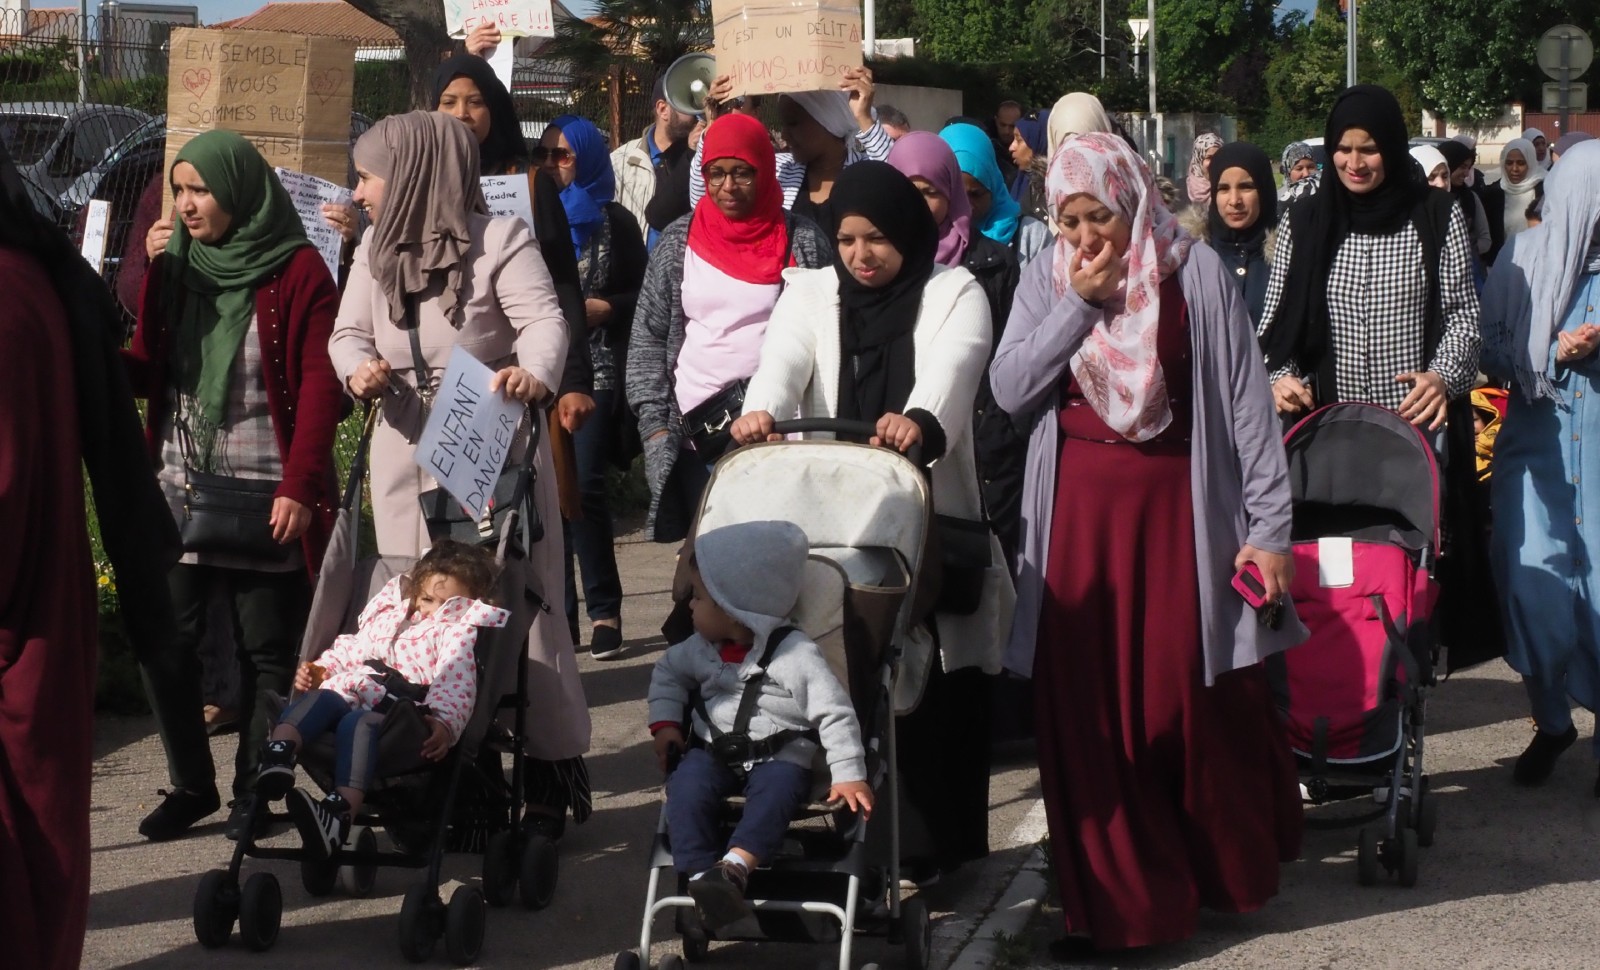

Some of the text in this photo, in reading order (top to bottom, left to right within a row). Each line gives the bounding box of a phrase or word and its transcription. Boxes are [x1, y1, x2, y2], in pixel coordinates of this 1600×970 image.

[465, 12, 518, 33] FARE
[722, 26, 758, 50] C'EST
[775, 25, 792, 38] UN
[185, 39, 306, 67] ENSEMBLE
[225, 75, 278, 94] NOUS
[188, 103, 305, 125] SOMMES PLUS
[430, 372, 481, 478] ENFANT
[462, 428, 485, 465] EN
[466, 413, 514, 516] DANGER
